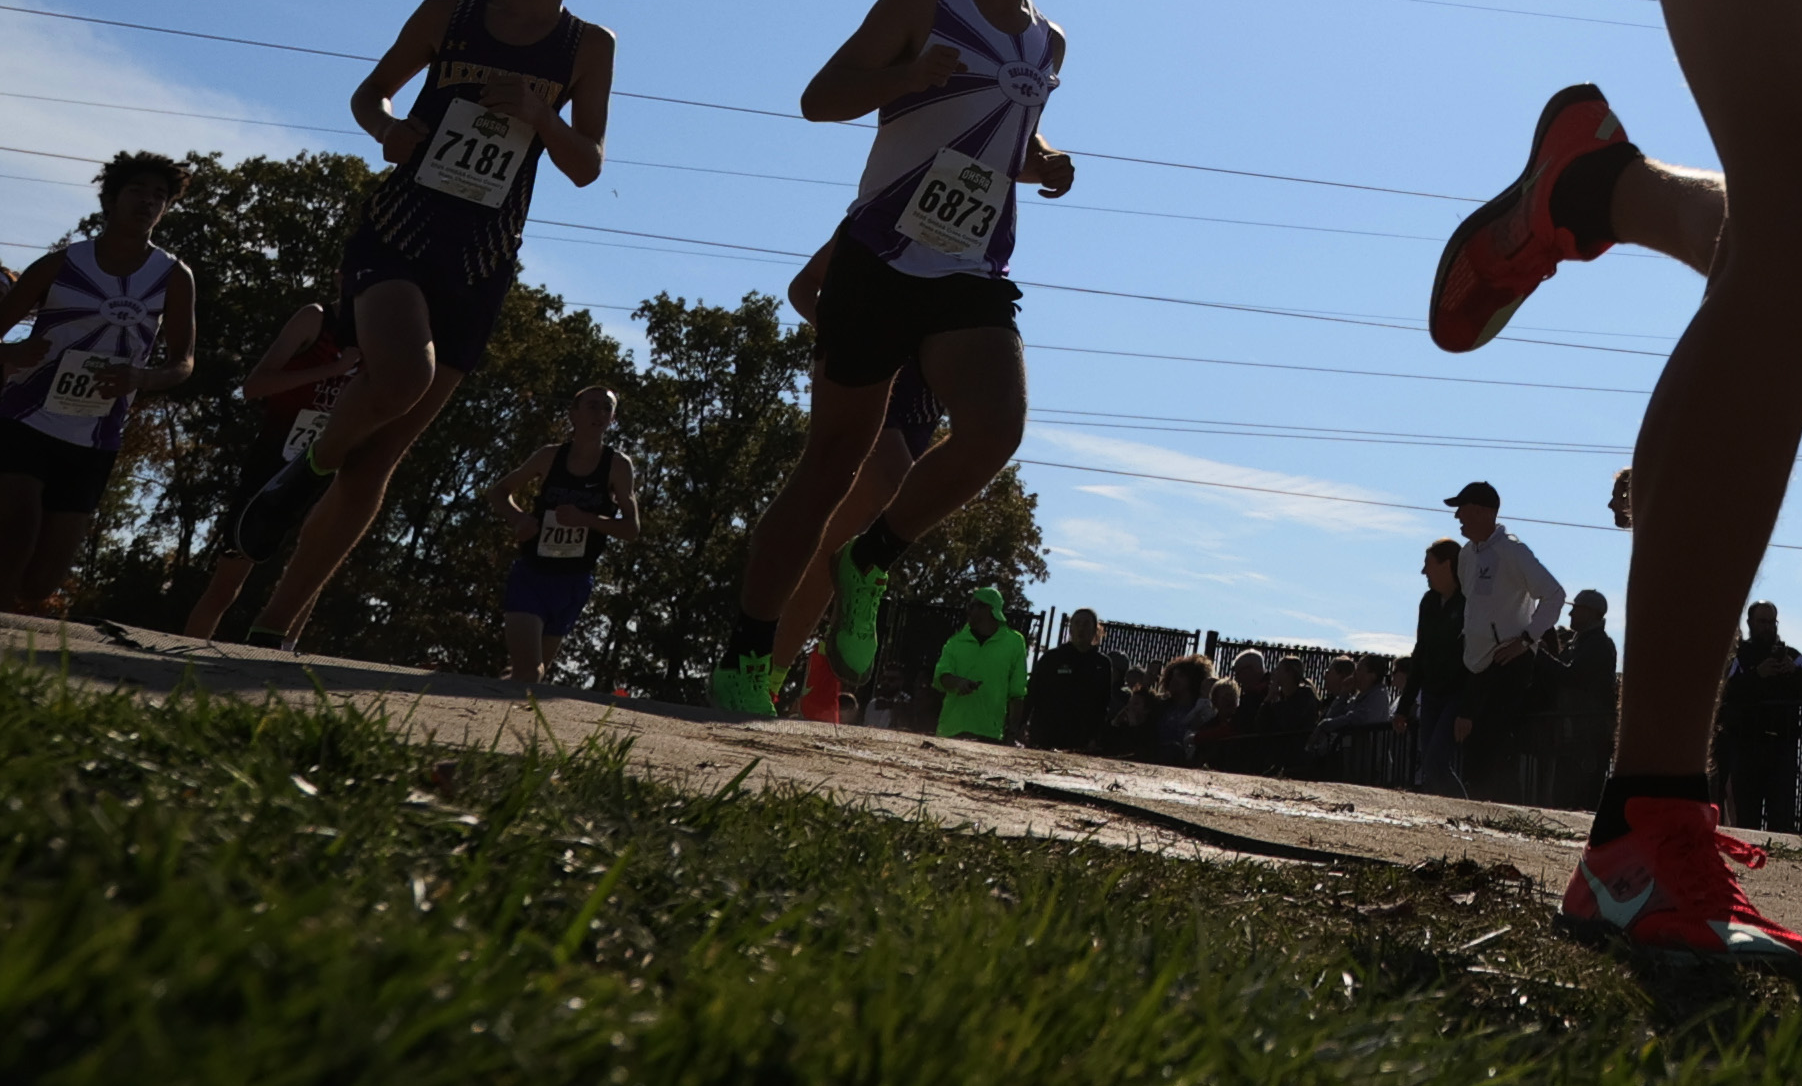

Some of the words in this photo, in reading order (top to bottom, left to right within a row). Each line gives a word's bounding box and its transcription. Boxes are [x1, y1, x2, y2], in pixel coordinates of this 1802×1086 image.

[437, 61, 564, 107] LEXITON
[474, 117, 508, 136] OHSAA
[433, 129, 514, 181] 7181
[961, 169, 991, 190] OHSAA
[918, 179, 996, 238] 6873
[314, 383, 341, 396] LIO
[289, 427, 318, 448] 73
[543, 526, 585, 544] 7013
